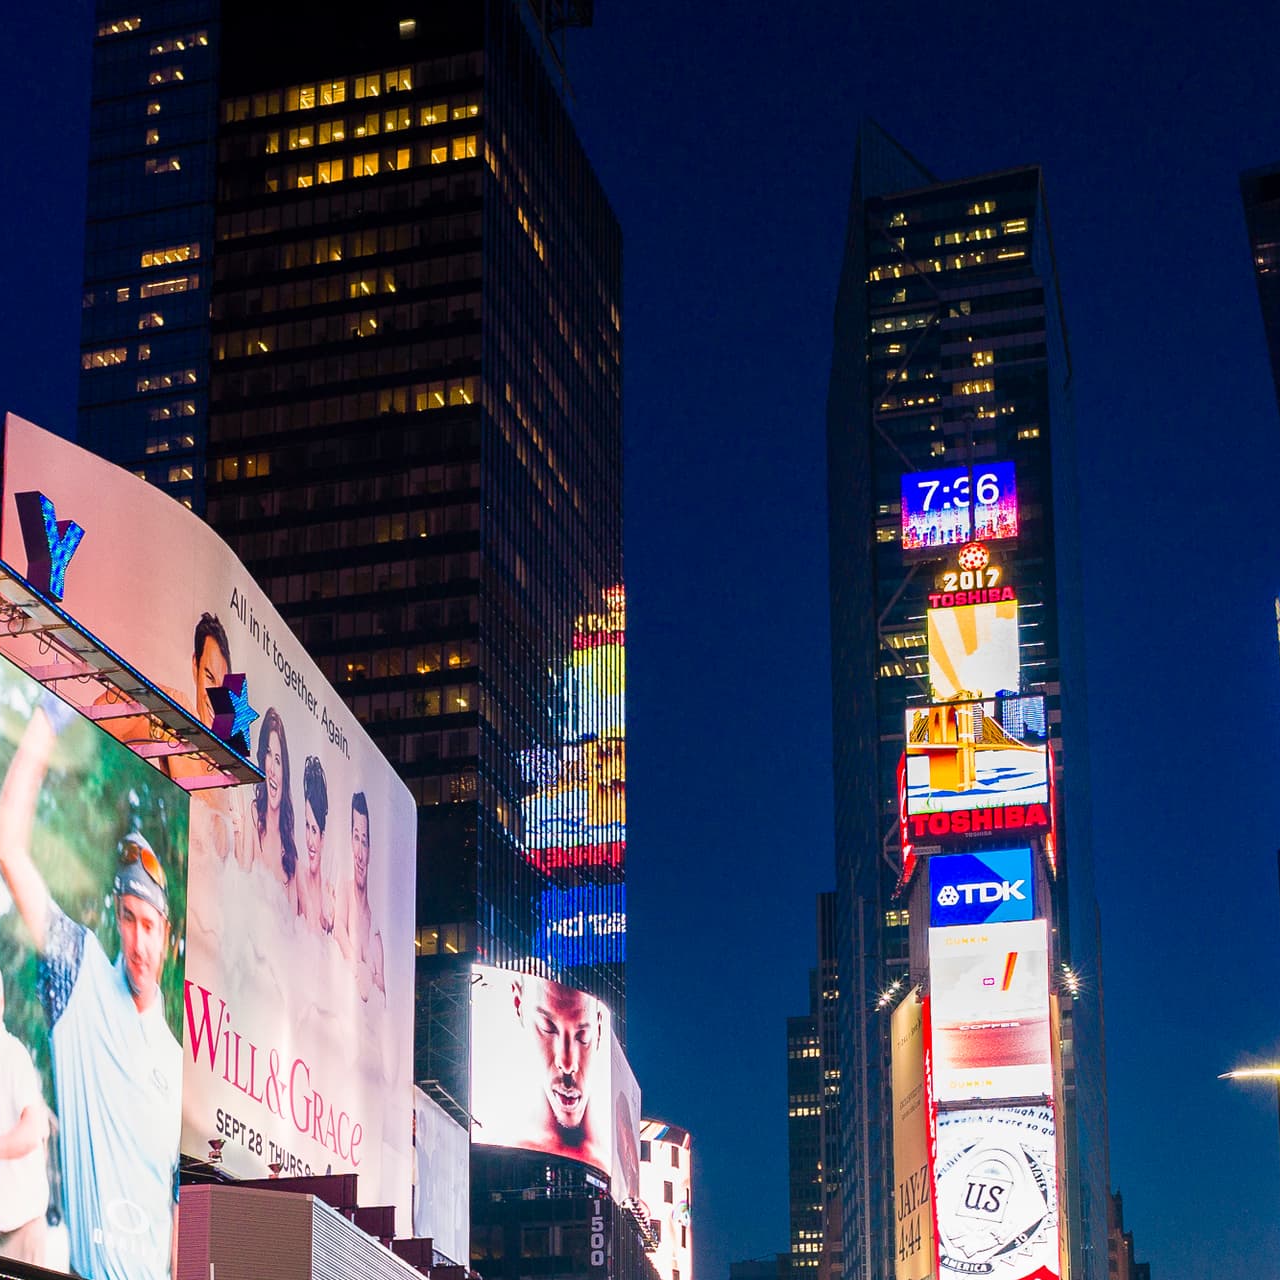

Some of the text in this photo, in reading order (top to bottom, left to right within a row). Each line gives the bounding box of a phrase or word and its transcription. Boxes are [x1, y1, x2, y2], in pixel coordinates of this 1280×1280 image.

[917, 472, 1000, 512] 7:36
[929, 586, 1015, 609] TOSHIBA
[943, 568, 1000, 593] 2017
[230, 587, 351, 761] All in it together. Again.
[909, 803, 1048, 837] TOSHIBA
[956, 879, 1027, 905] TDK
[215, 1108, 263, 1157] SEPT 28
[964, 1182, 1005, 1213] US
[590, 1199, 605, 1266] 1500
